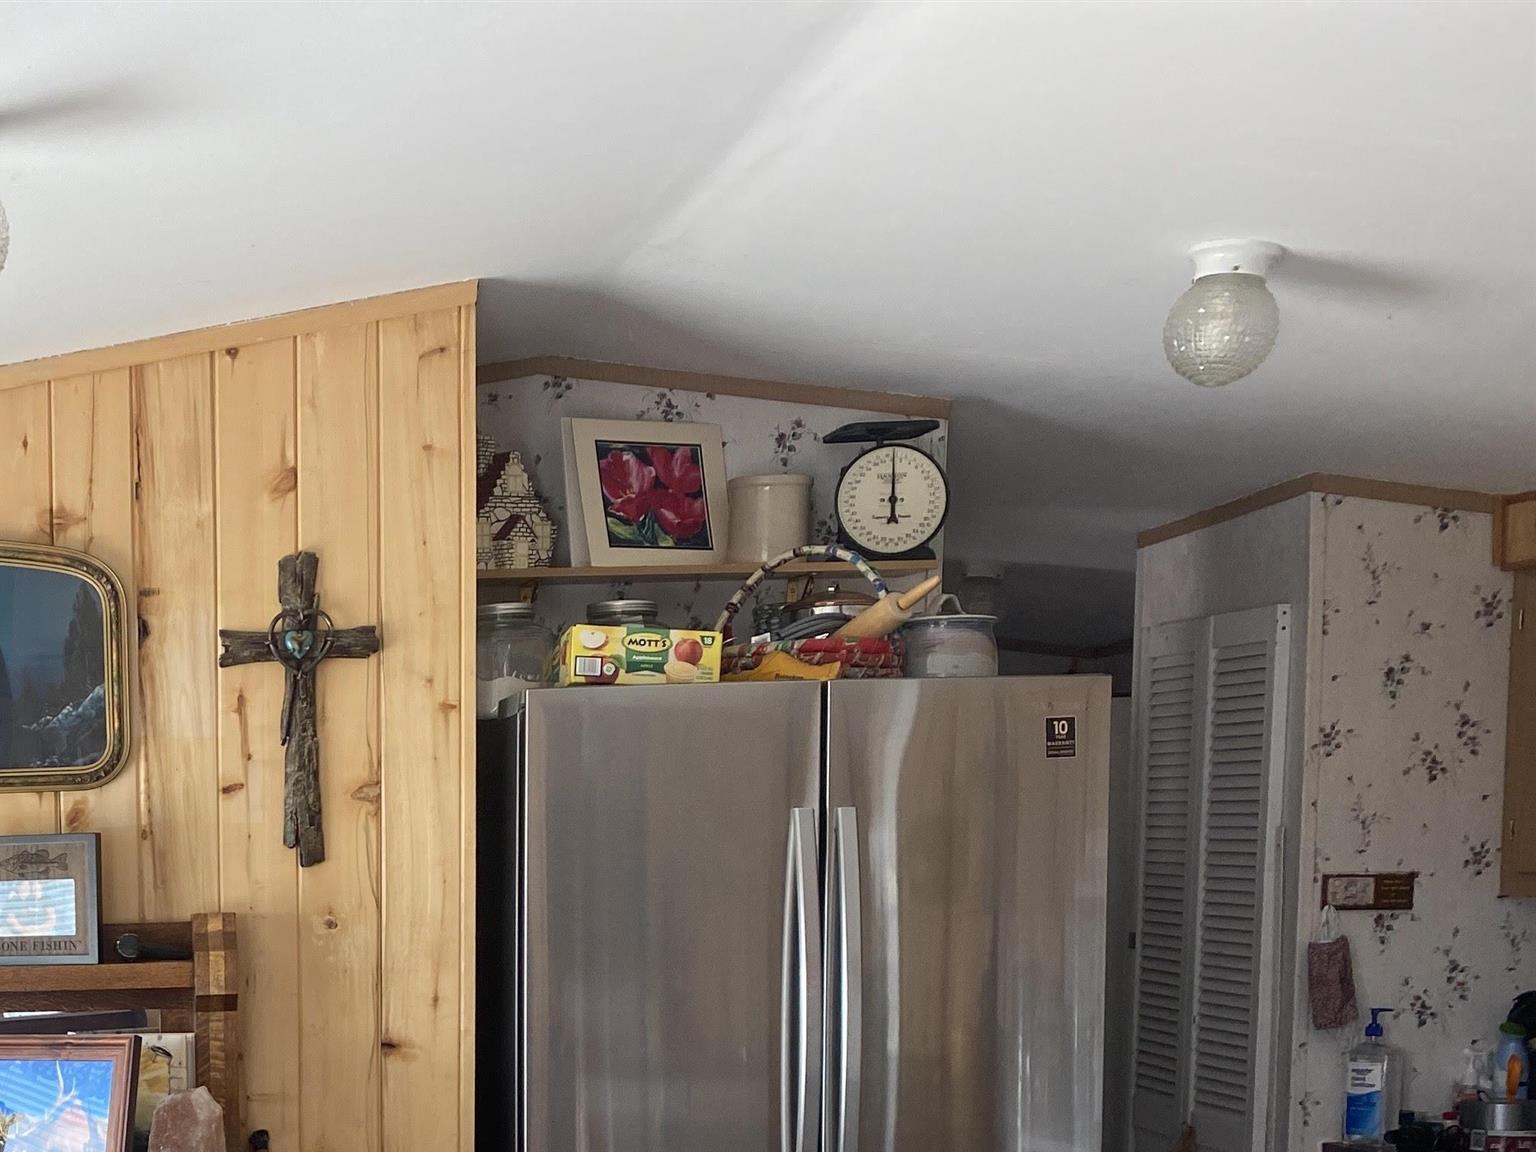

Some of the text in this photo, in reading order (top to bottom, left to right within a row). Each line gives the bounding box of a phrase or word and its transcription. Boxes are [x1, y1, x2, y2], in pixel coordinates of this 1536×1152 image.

[703, 637, 713, 645] 18
[1053, 720, 1068, 734] 10
[32, 940, 82, 952] FISHIN'
